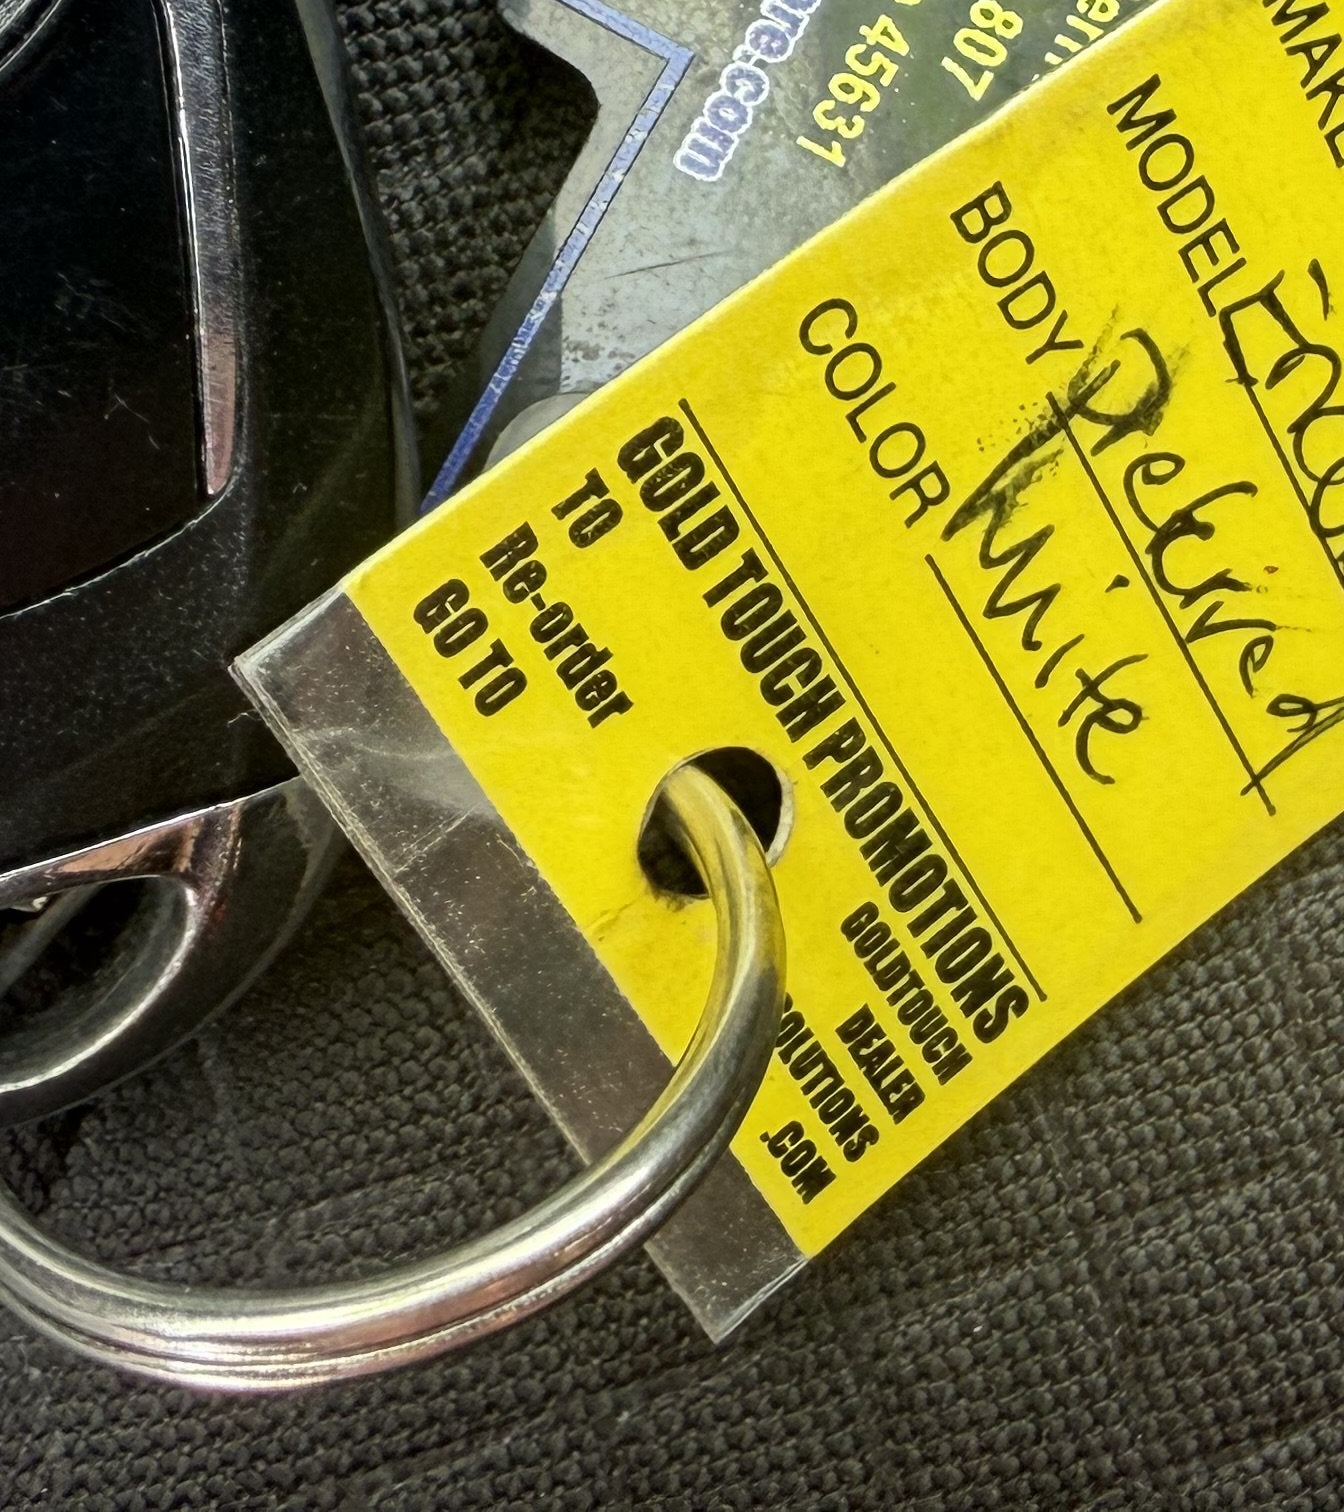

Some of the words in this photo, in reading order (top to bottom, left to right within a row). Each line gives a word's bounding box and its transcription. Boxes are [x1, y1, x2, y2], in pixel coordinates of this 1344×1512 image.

[800, 16, 910, 166] 45631
[944, 0, 1024, 100] 807
[951, 182, 1083, 363] BODY
[1107, 75, 1246, 316] MODEL
[800, 299, 949, 527] COLOR
[552, 469, 622, 548] TO
[414, 579, 488, 657] GO
[459, 639, 526, 716] TO
[480, 523, 633, 728] Re-order
[618, 417, 739, 570] GOLD
[703, 550, 845, 742] TOUCH
[803, 718, 1029, 1043] PROMOTIONS
[836, 1005, 925, 1124] DEALER
[841, 902, 972, 1085] GOLDTOUCH
[760, 1121, 836, 1204] .COM
